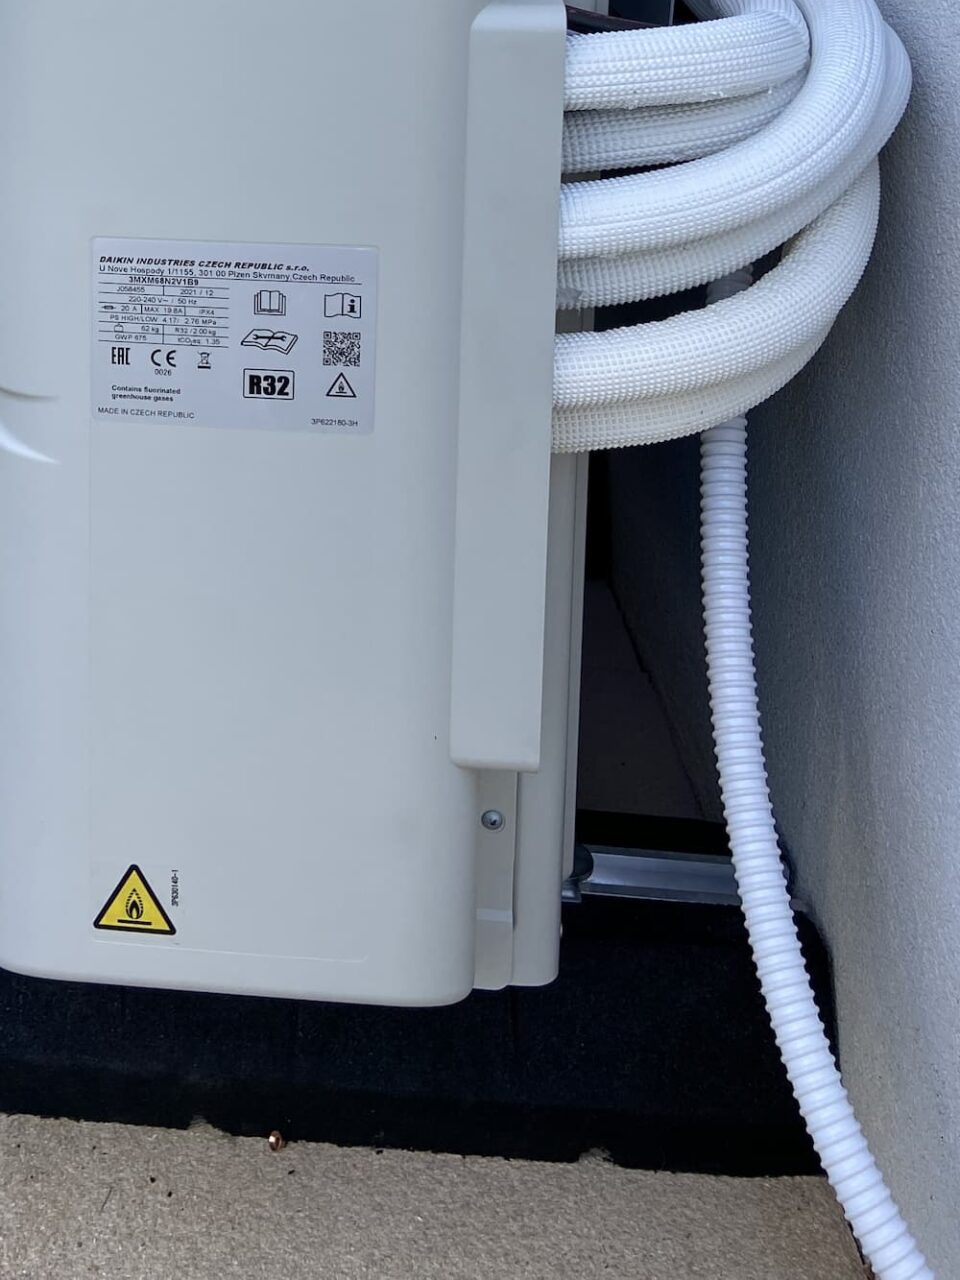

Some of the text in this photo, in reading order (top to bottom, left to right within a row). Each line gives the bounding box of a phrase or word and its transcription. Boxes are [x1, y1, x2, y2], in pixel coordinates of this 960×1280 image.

[99, 256, 134, 264] DAIKIN
[136, 257, 195, 267] INDUSTRIES
[198, 260, 232, 268] CZECH
[233, 261, 284, 270] REPUBLIC
[320, 273, 355, 283] Republic
[111, 384, 142, 392] Contains
[248, 375, 290, 396] R32
[97, 407, 119, 415] MADE
[129, 409, 156, 417] CZECH
[157, 410, 195, 419] REPUBLIC
